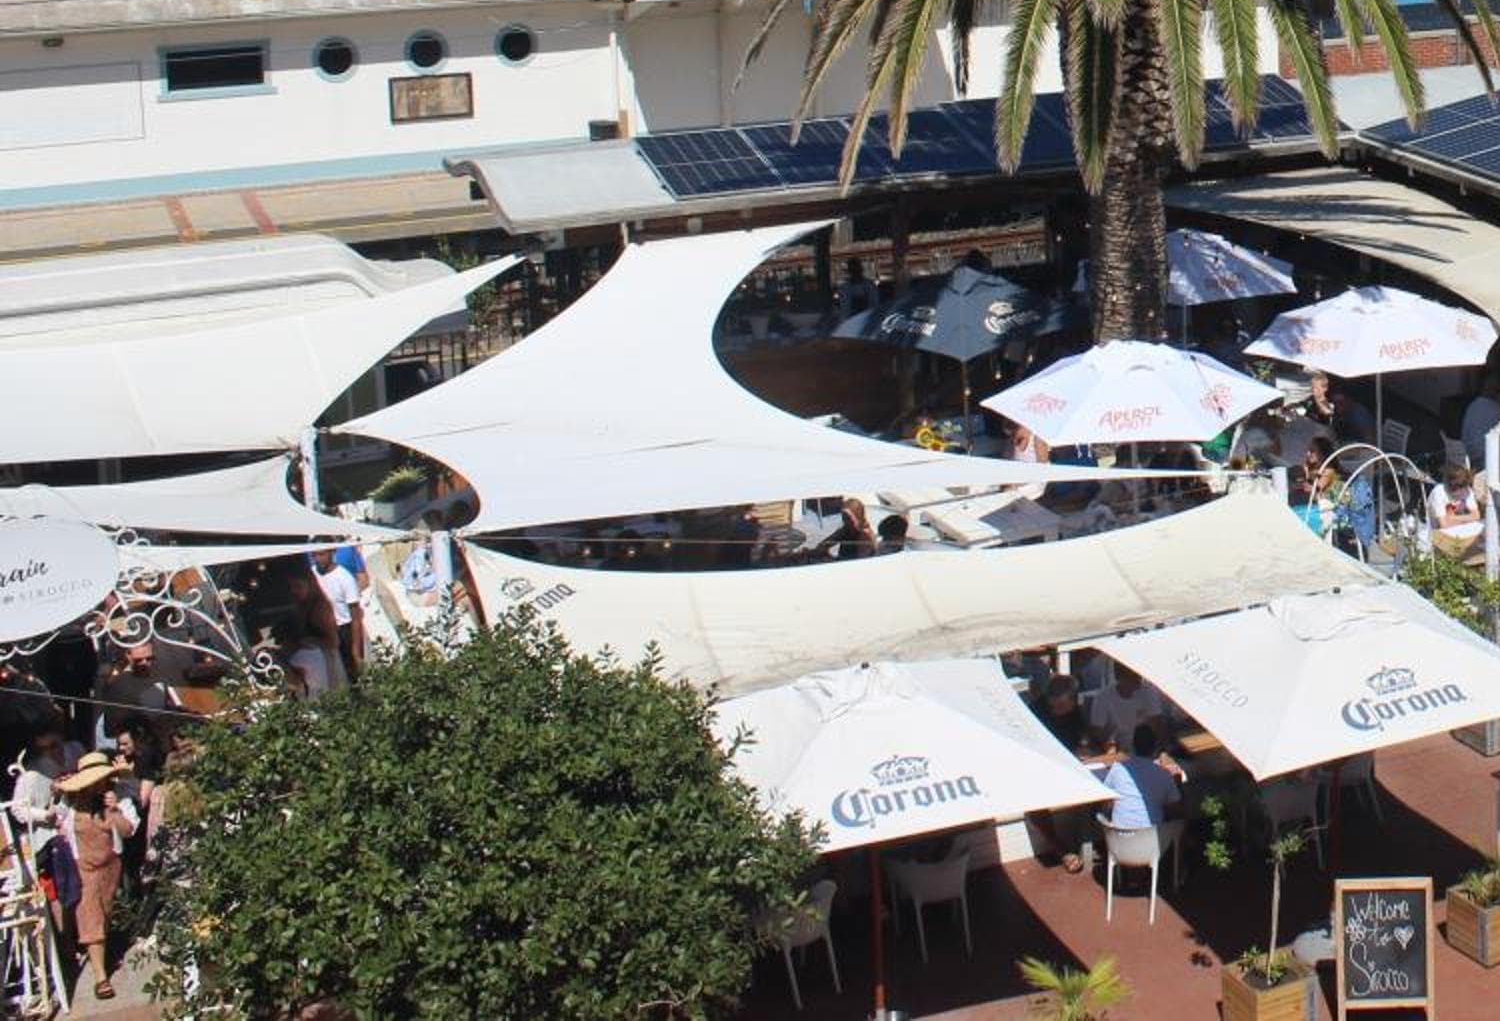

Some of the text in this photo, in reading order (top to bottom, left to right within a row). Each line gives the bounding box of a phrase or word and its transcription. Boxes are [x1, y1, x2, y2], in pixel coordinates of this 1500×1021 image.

[1099, 406, 1165, 429] APEROL
[1341, 684, 1467, 731] Corona
[831, 776, 981, 829] Corona
